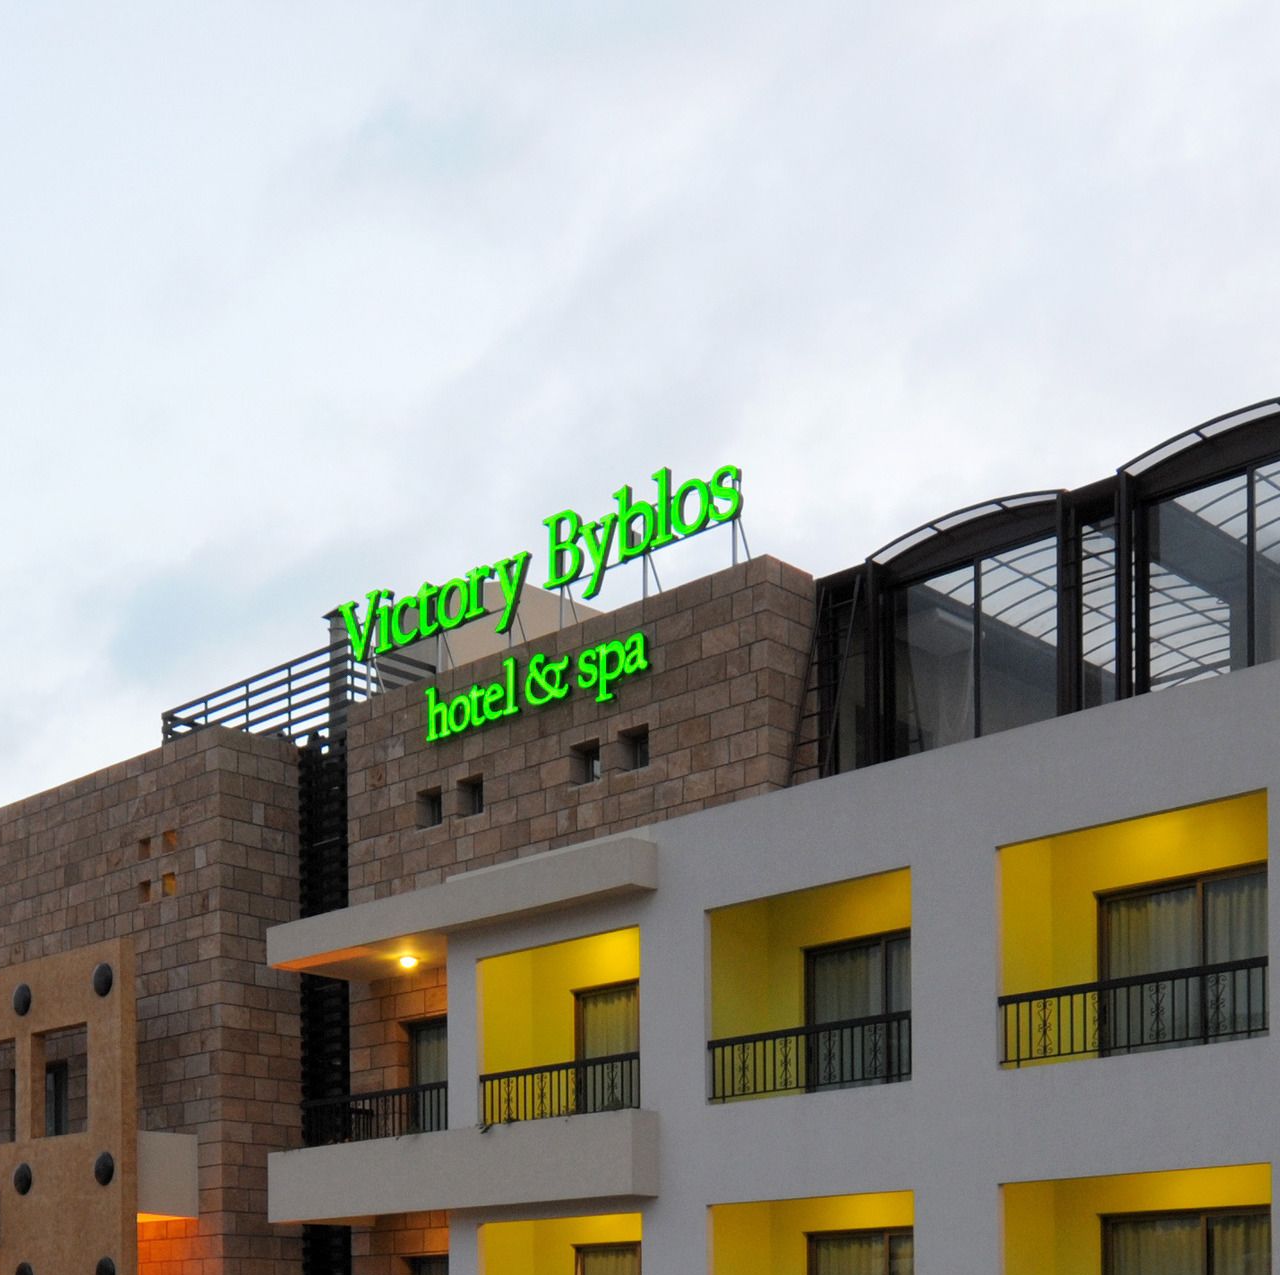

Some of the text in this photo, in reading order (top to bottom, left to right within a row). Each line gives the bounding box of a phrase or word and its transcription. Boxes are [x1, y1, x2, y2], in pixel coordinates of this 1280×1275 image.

[337, 465, 742, 664] Victory Byblos
[423, 630, 649, 744] hotel & spa
